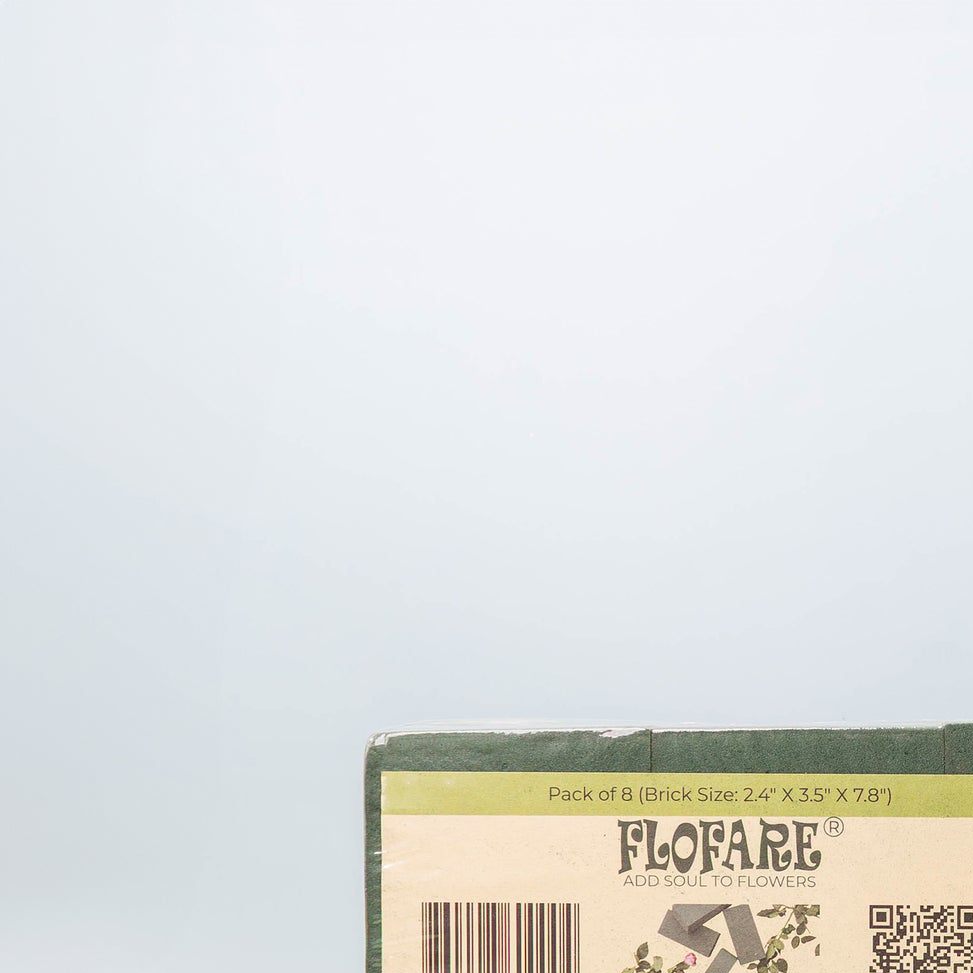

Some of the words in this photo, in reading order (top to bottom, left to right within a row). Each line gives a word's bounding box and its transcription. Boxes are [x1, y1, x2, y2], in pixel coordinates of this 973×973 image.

[548, 787, 592, 802] Pack
[598, 787, 616, 802] of
[621, 787, 633, 802] 8
[639, 786, 692, 805] (Brick
[697, 787, 738, 802] Size:
[743, 787, 777, 803] 2.4"
[781, 787, 794, 802] X
[798, 787, 831, 803] 3.5"
[836, 787, 849, 803] X
[617, 817, 822, 874] FLOFARE
[623, 875, 659, 887] ADD
[664, 875, 707, 887] SOUL
[711, 875, 733, 887] TO
[737, 875, 816, 888] FLOWERS
